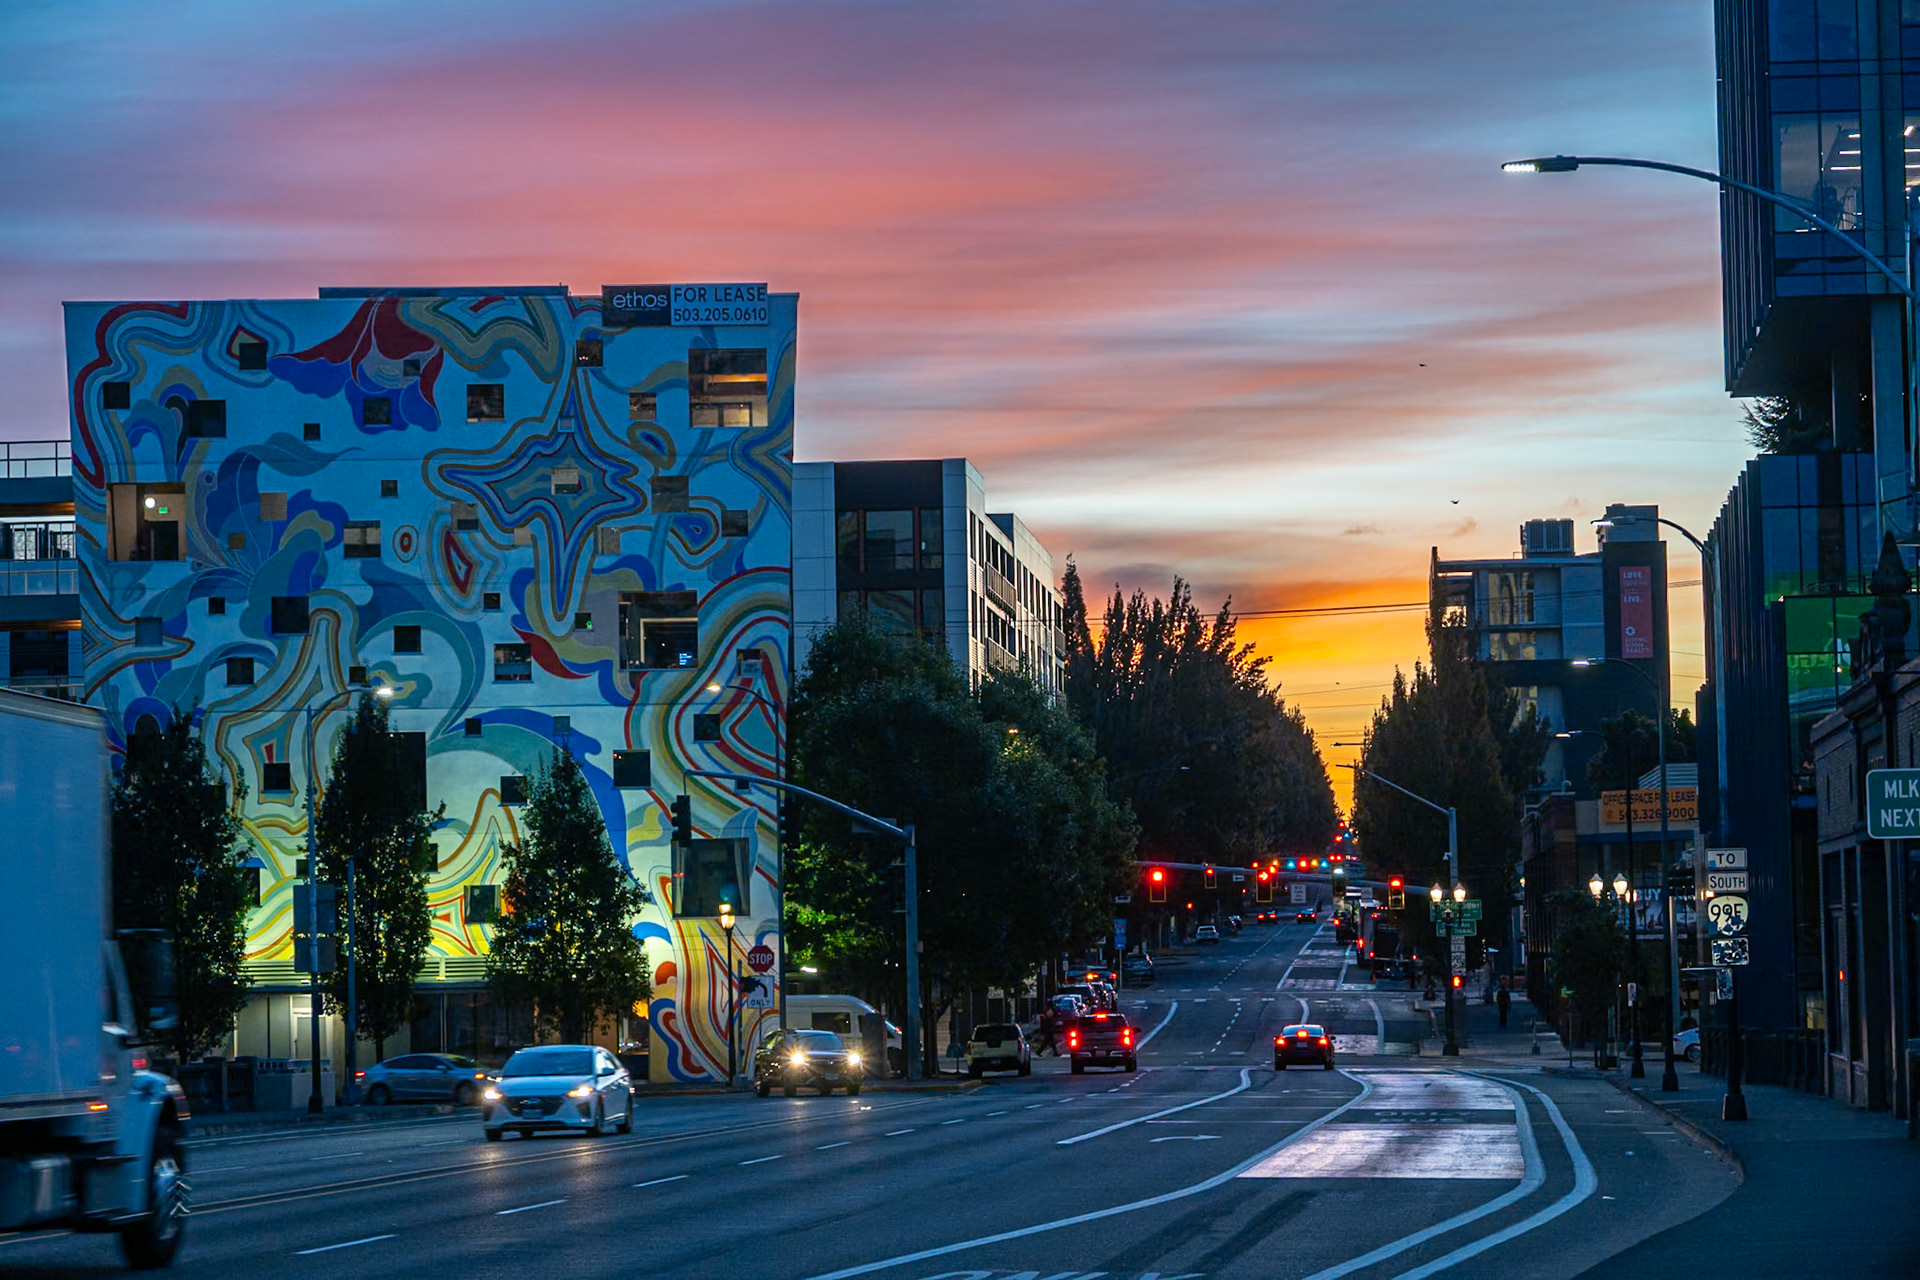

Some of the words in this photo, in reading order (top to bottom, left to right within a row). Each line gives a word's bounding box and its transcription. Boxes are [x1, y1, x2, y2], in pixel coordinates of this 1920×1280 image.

[613, 291, 668, 308] ethos
[674, 287, 707, 303] FOR
[714, 286, 766, 302] LEASE
[674, 307, 767, 322] 503.205.0610
[1671, 790, 1695, 802] LEASE
[1884, 779, 1920, 799] MLK
[1716, 853, 1736, 865] TO
[1709, 875, 1746, 889] SOUTH
[749, 953, 773, 965] STOP
[750, 998, 771, 1007] ONLY
